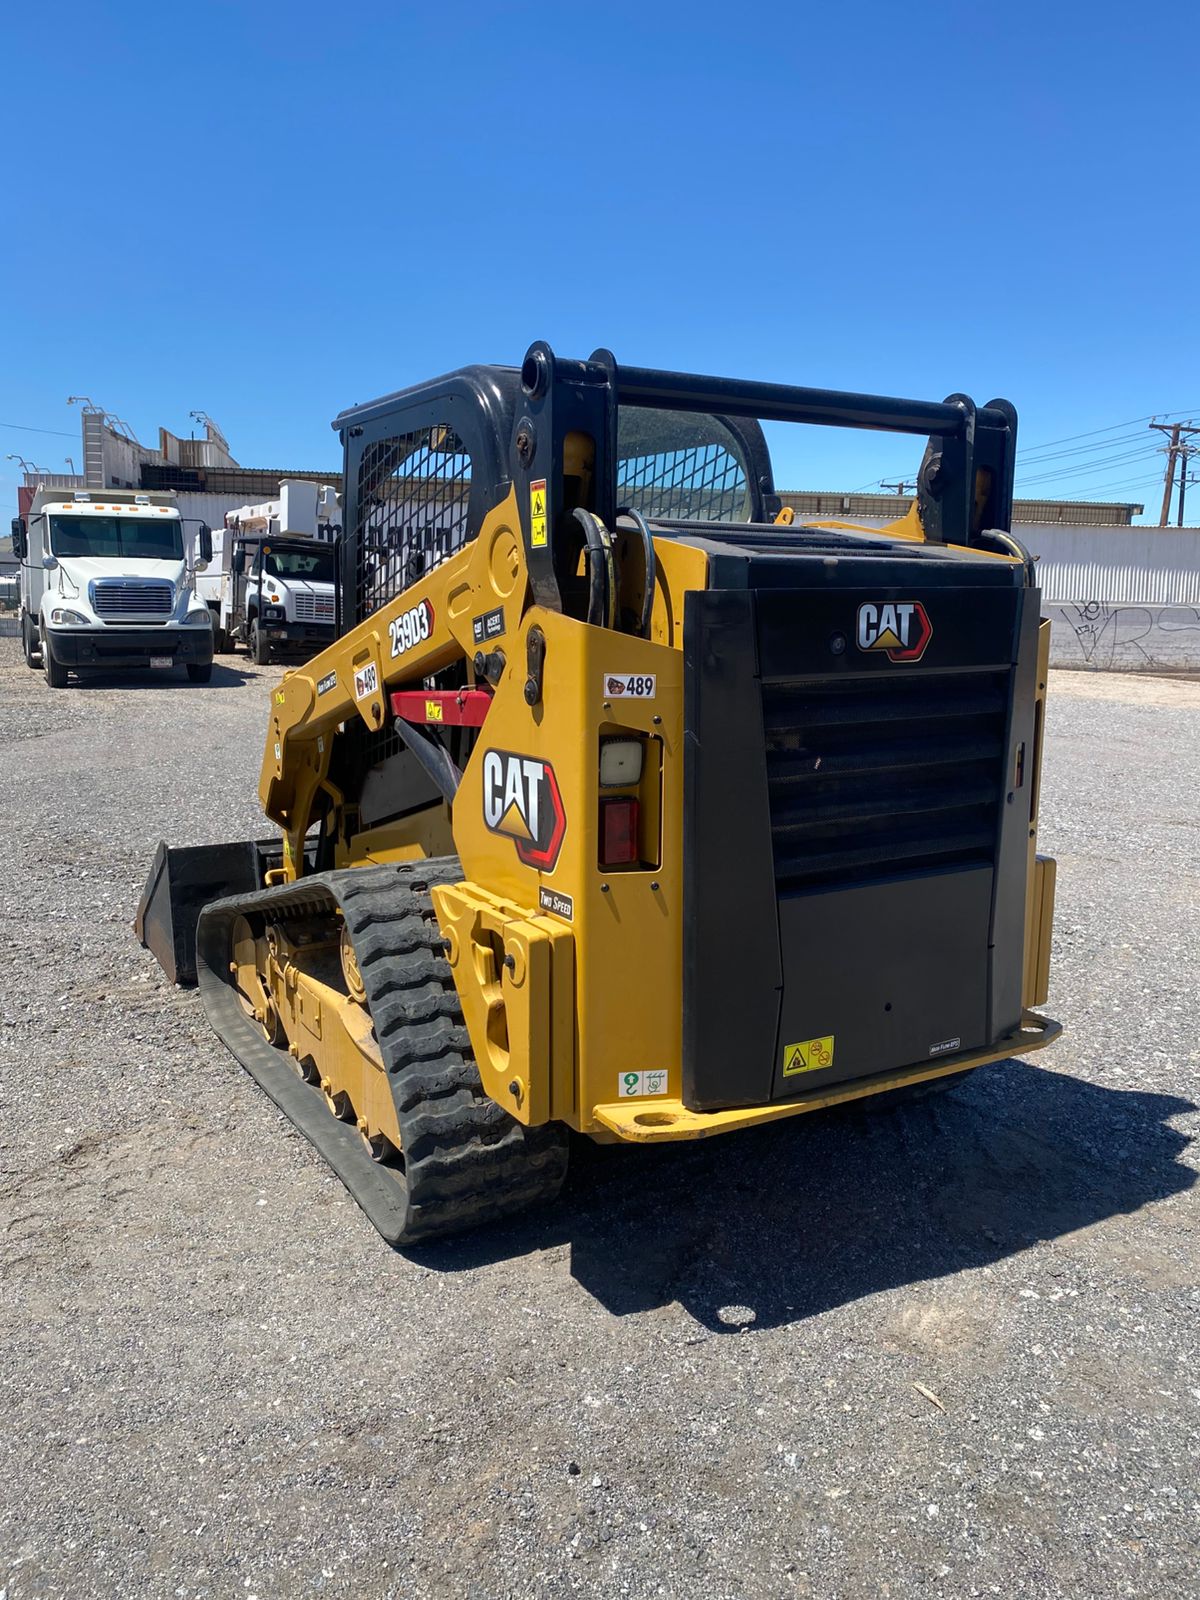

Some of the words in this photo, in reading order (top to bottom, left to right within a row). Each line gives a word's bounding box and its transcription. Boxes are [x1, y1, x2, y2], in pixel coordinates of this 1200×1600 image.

[388, 601, 429, 659] 259D3
[859, 603, 914, 649] CAT
[364, 666, 376, 692] 489
[626, 677, 653, 695] 489
[484, 751, 543, 842] CAT
